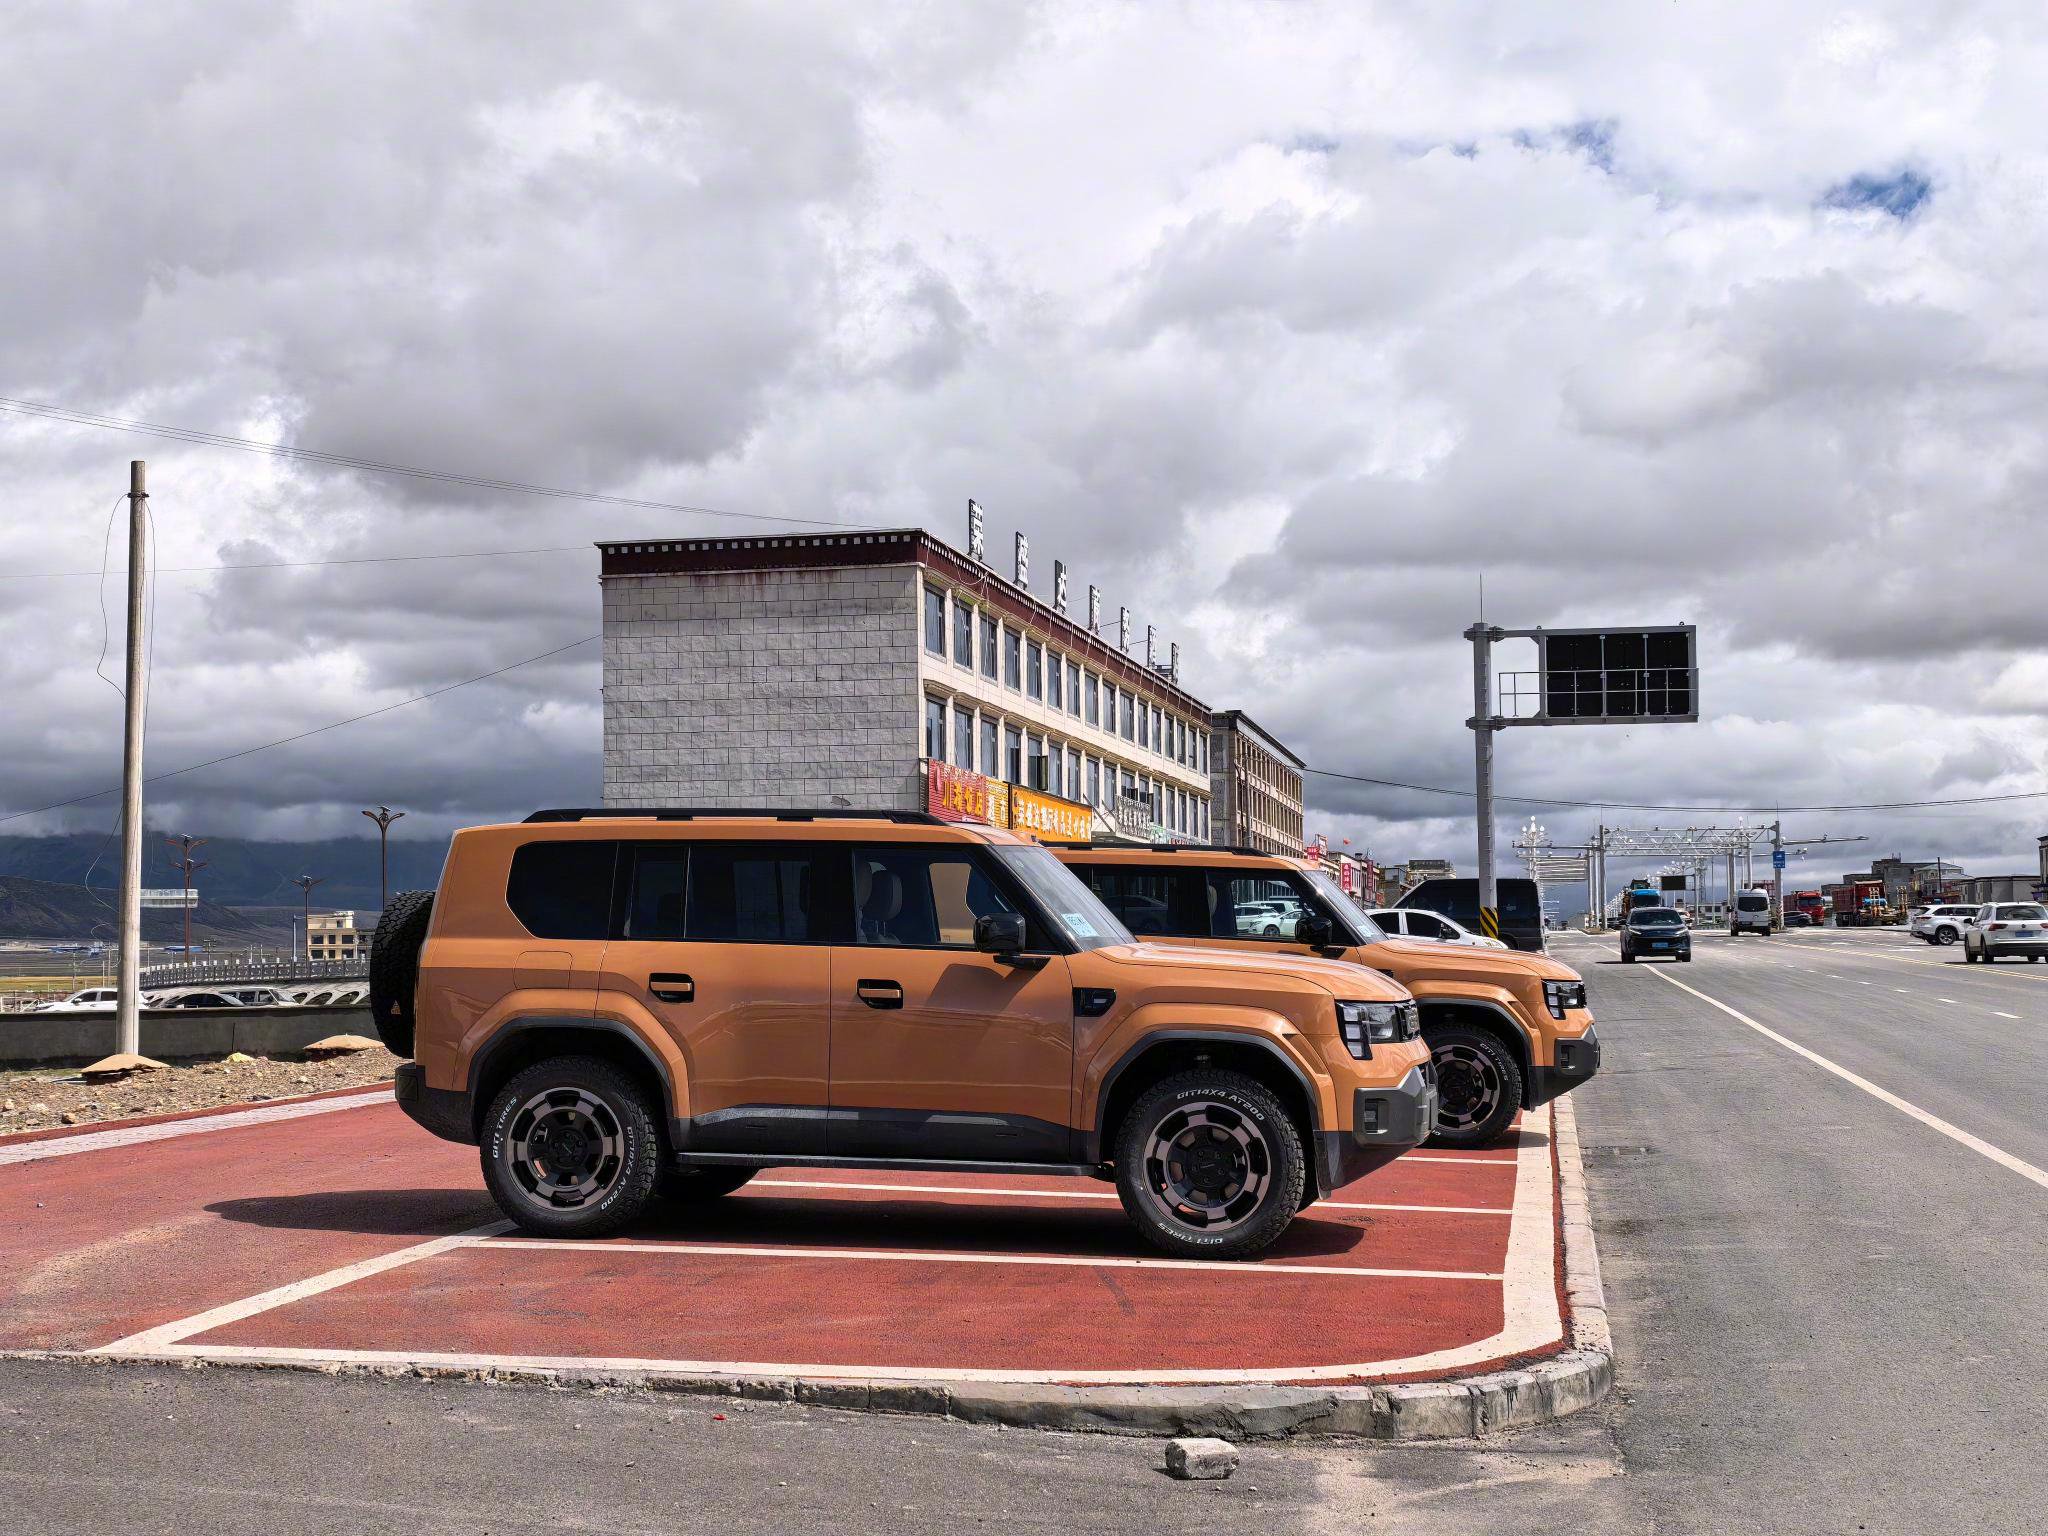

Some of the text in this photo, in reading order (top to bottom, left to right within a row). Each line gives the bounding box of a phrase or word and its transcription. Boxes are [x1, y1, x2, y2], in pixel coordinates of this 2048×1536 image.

[492, 1096, 517, 1159] GITI TIRES
[1196, 1237, 1224, 1245] GITI
